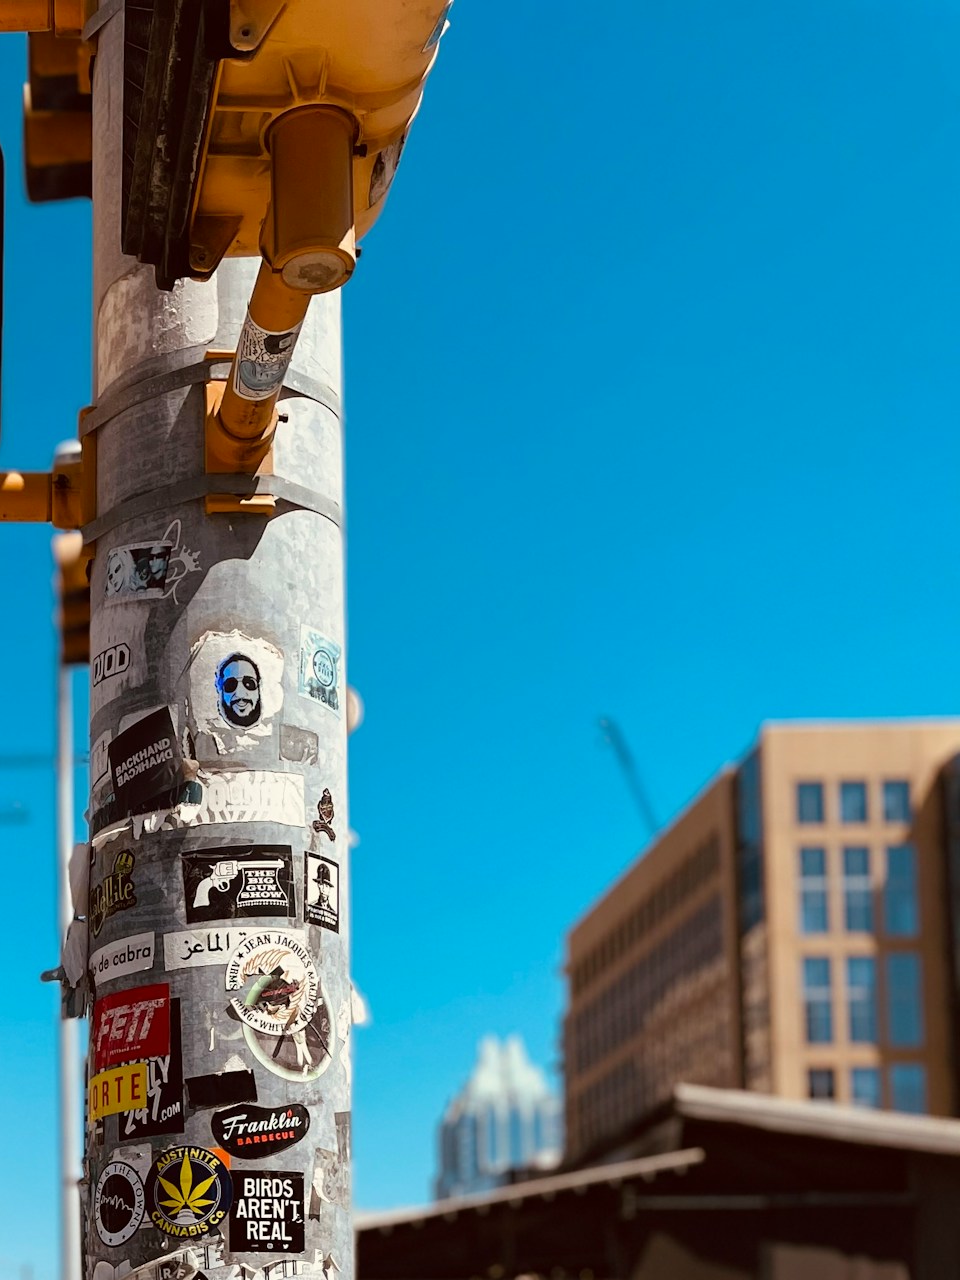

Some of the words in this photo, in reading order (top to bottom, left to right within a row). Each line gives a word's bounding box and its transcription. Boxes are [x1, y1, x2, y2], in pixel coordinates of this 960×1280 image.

[115, 738, 171, 778] BACKHAND
[98, 954, 109, 973] de
[113, 944, 151, 966] cabra
[244, 934, 271, 954] JEAN
[275, 935, 311, 968] JACQUES
[222, 1110, 302, 1140] Franklin
[236, 1131, 295, 1146] BARBECUE
[156, 1147, 220, 1172] AUSTINITE
[113, 1165, 132, 1180] THE
[130, 1179, 143, 1229] TOWNS
[244, 1177, 294, 1198] BIRDS
[151, 1210, 209, 1237] CANNABIS
[236, 1199, 301, 1221] AREN'T
[246, 1221, 292, 1241] REAL
